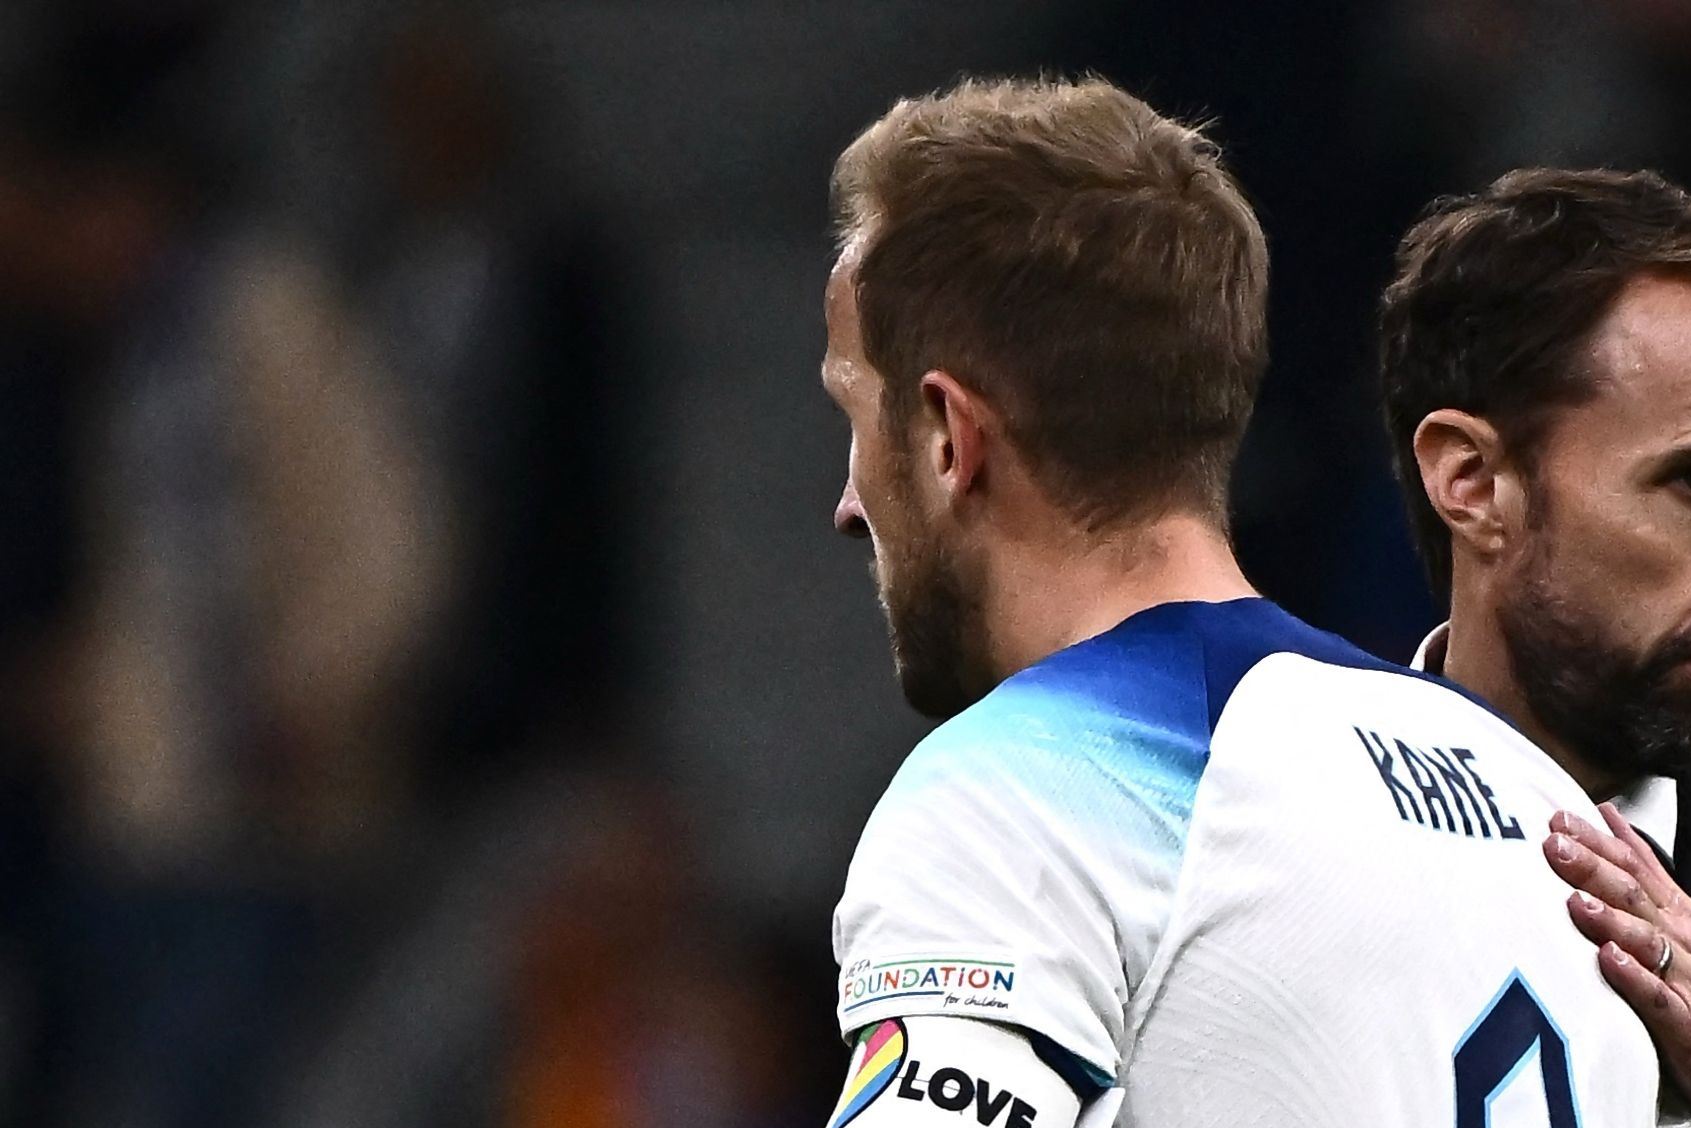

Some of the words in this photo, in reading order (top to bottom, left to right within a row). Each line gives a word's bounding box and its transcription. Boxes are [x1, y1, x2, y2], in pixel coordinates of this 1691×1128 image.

[1352, 724, 1527, 841] KANE
[844, 966, 1015, 1001] FOUNDATION
[943, 992, 961, 1008] for
[963, 993, 1010, 1010] children
